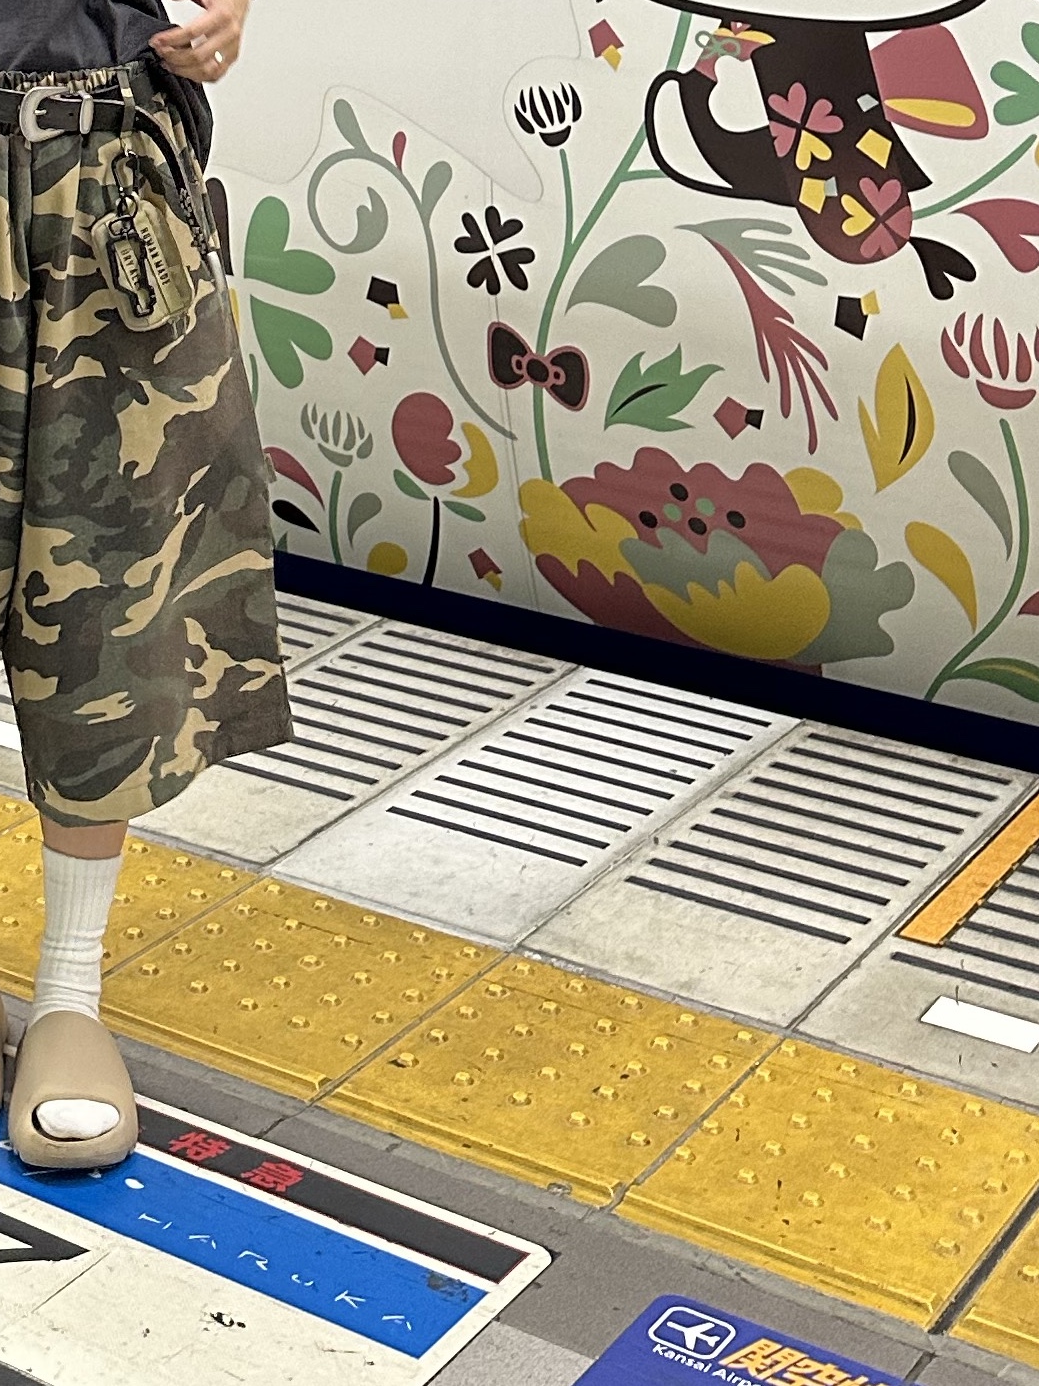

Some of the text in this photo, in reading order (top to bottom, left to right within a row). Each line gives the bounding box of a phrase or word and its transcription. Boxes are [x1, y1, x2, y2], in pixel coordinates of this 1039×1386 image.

[154, 259, 171, 286] MADE
[168, 1131, 305, 1192] 特急
[138, 1213, 412, 1330] HARUKA
[652, 1343, 762, 1386] Kansai Airp
